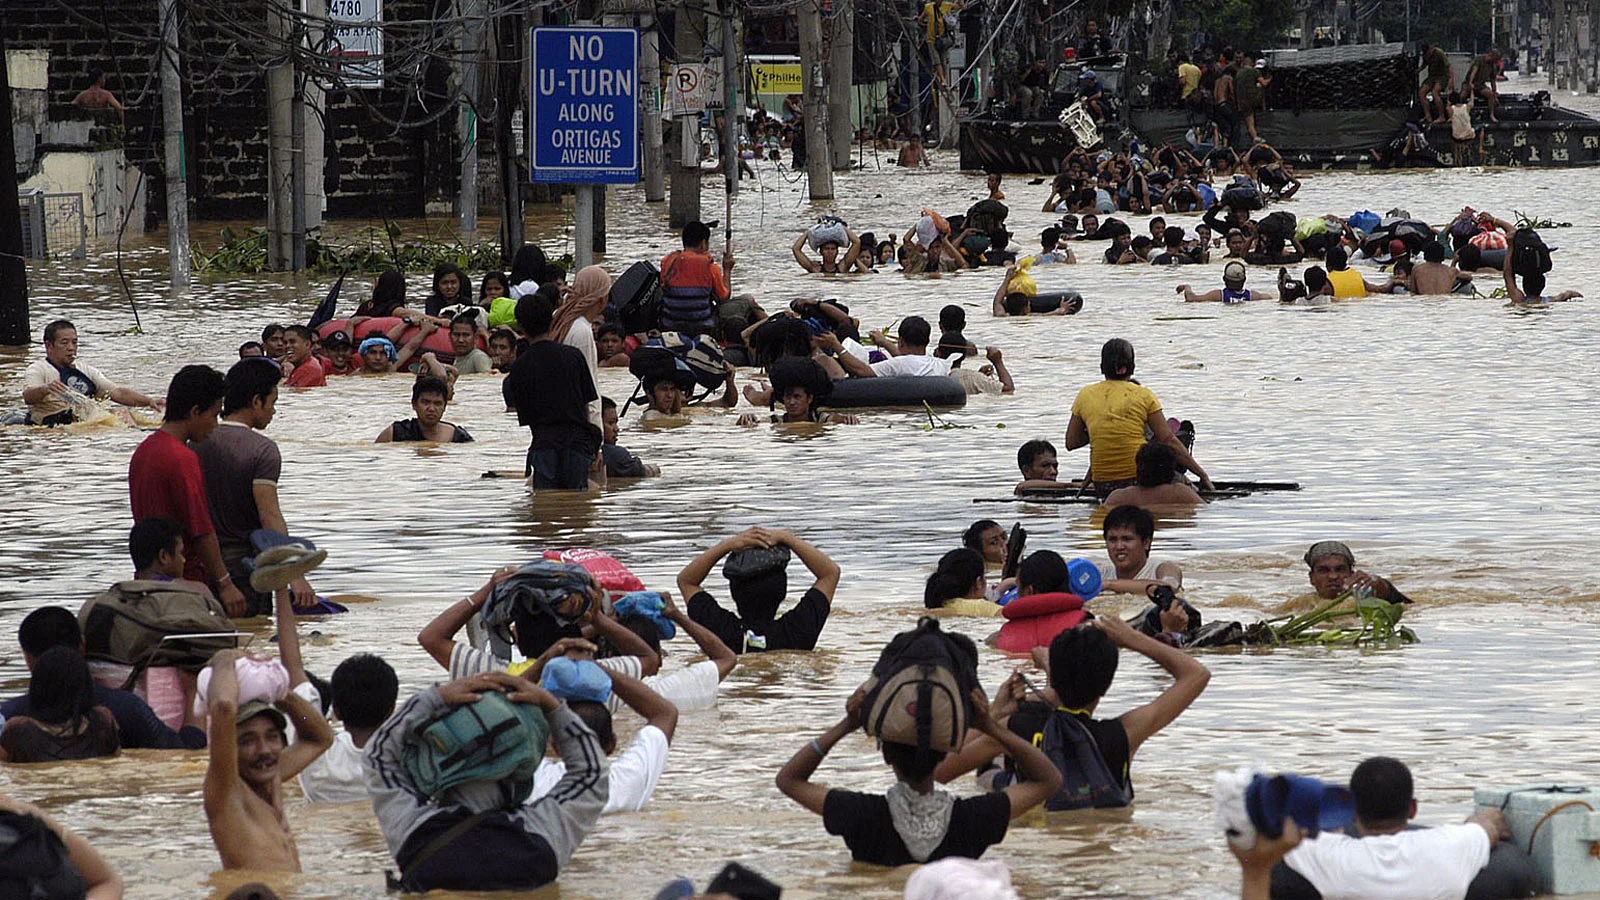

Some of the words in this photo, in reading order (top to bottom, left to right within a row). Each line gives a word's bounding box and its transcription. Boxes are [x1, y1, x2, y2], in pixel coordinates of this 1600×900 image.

[569, 35, 604, 61] NO
[540, 68, 631, 96] U-TURN
[558, 103, 614, 122] ALONG
[552, 129, 621, 148] ORTIGAS
[561, 149, 611, 164] AVENUE
